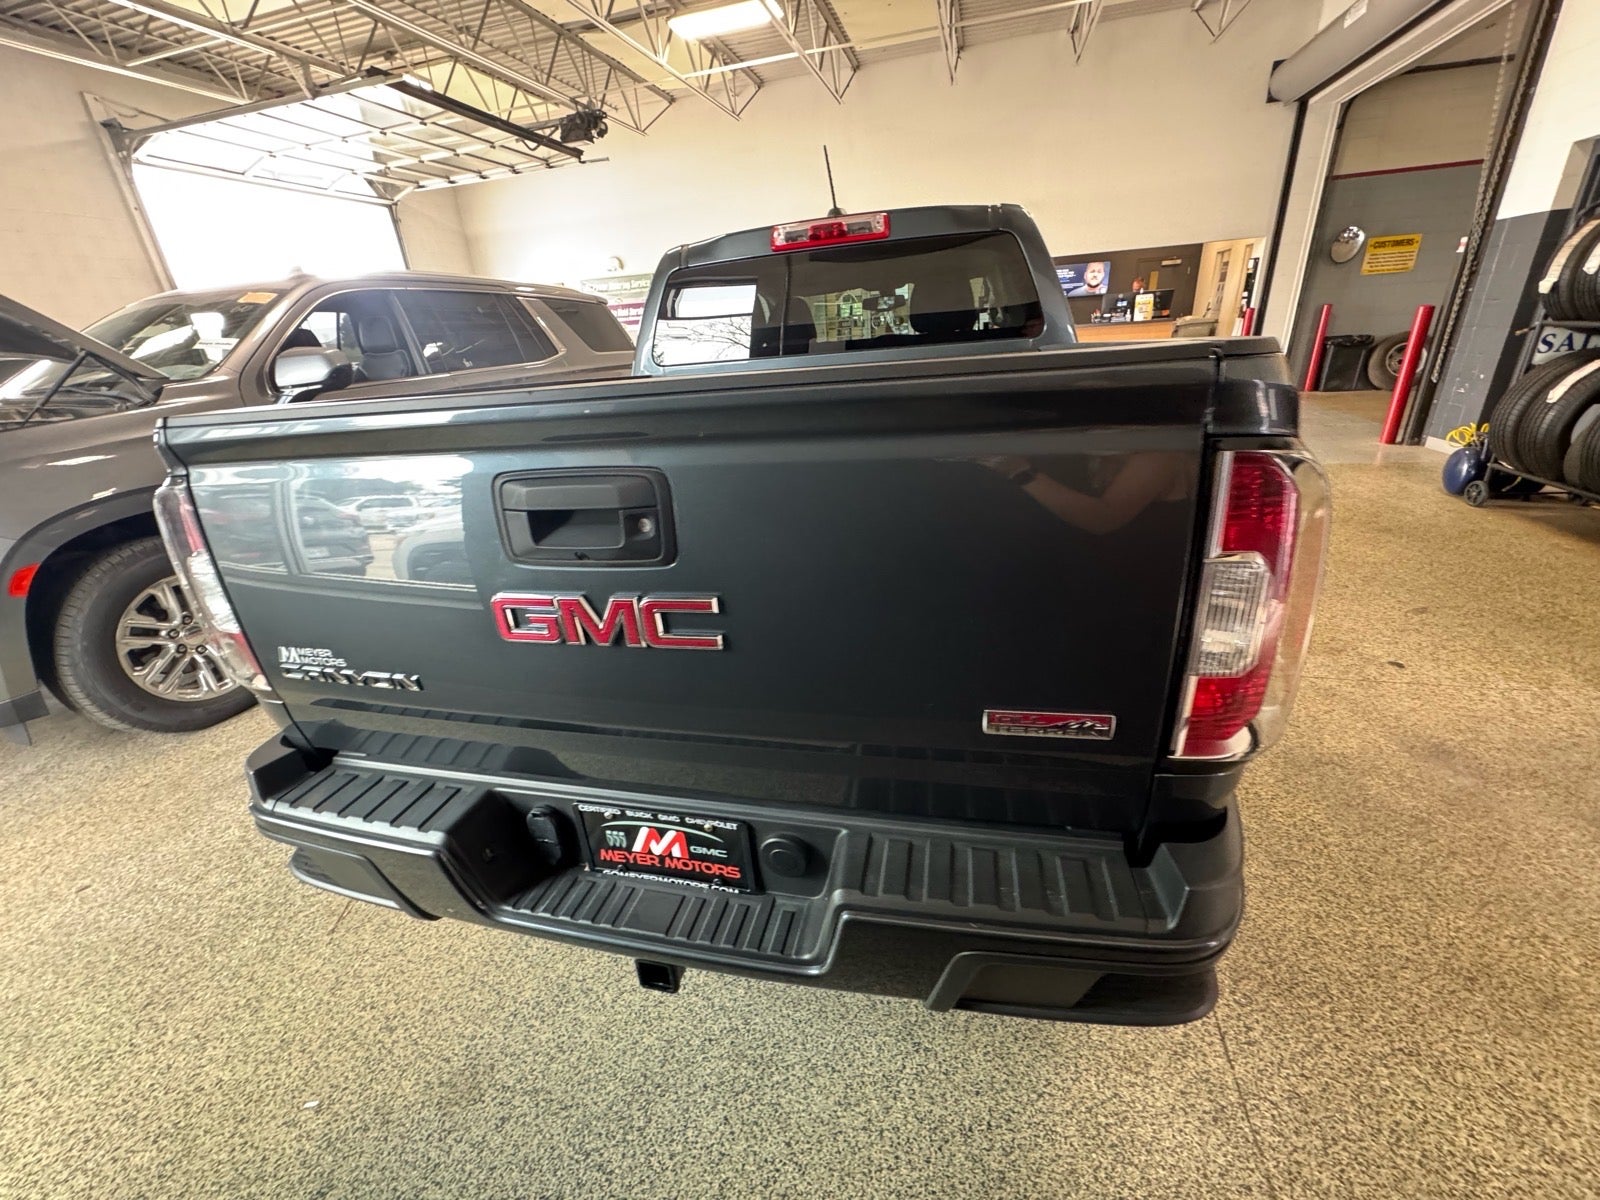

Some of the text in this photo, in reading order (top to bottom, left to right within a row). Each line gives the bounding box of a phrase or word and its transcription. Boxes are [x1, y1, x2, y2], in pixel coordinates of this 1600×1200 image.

[490, 591, 724, 651] GMC
[298, 647, 333, 658] MEYER
[300, 656, 347, 668] MOTORS
[279, 663, 423, 692] CANYON
[578, 804, 738, 830] CERTIFIED BUICK GMC CHEVROLET
[600, 848, 741, 879] MEYER MOTORS
[690, 845, 728, 858] GMC
[603, 869, 739, 893] GOMEYERMOTORSCOM
